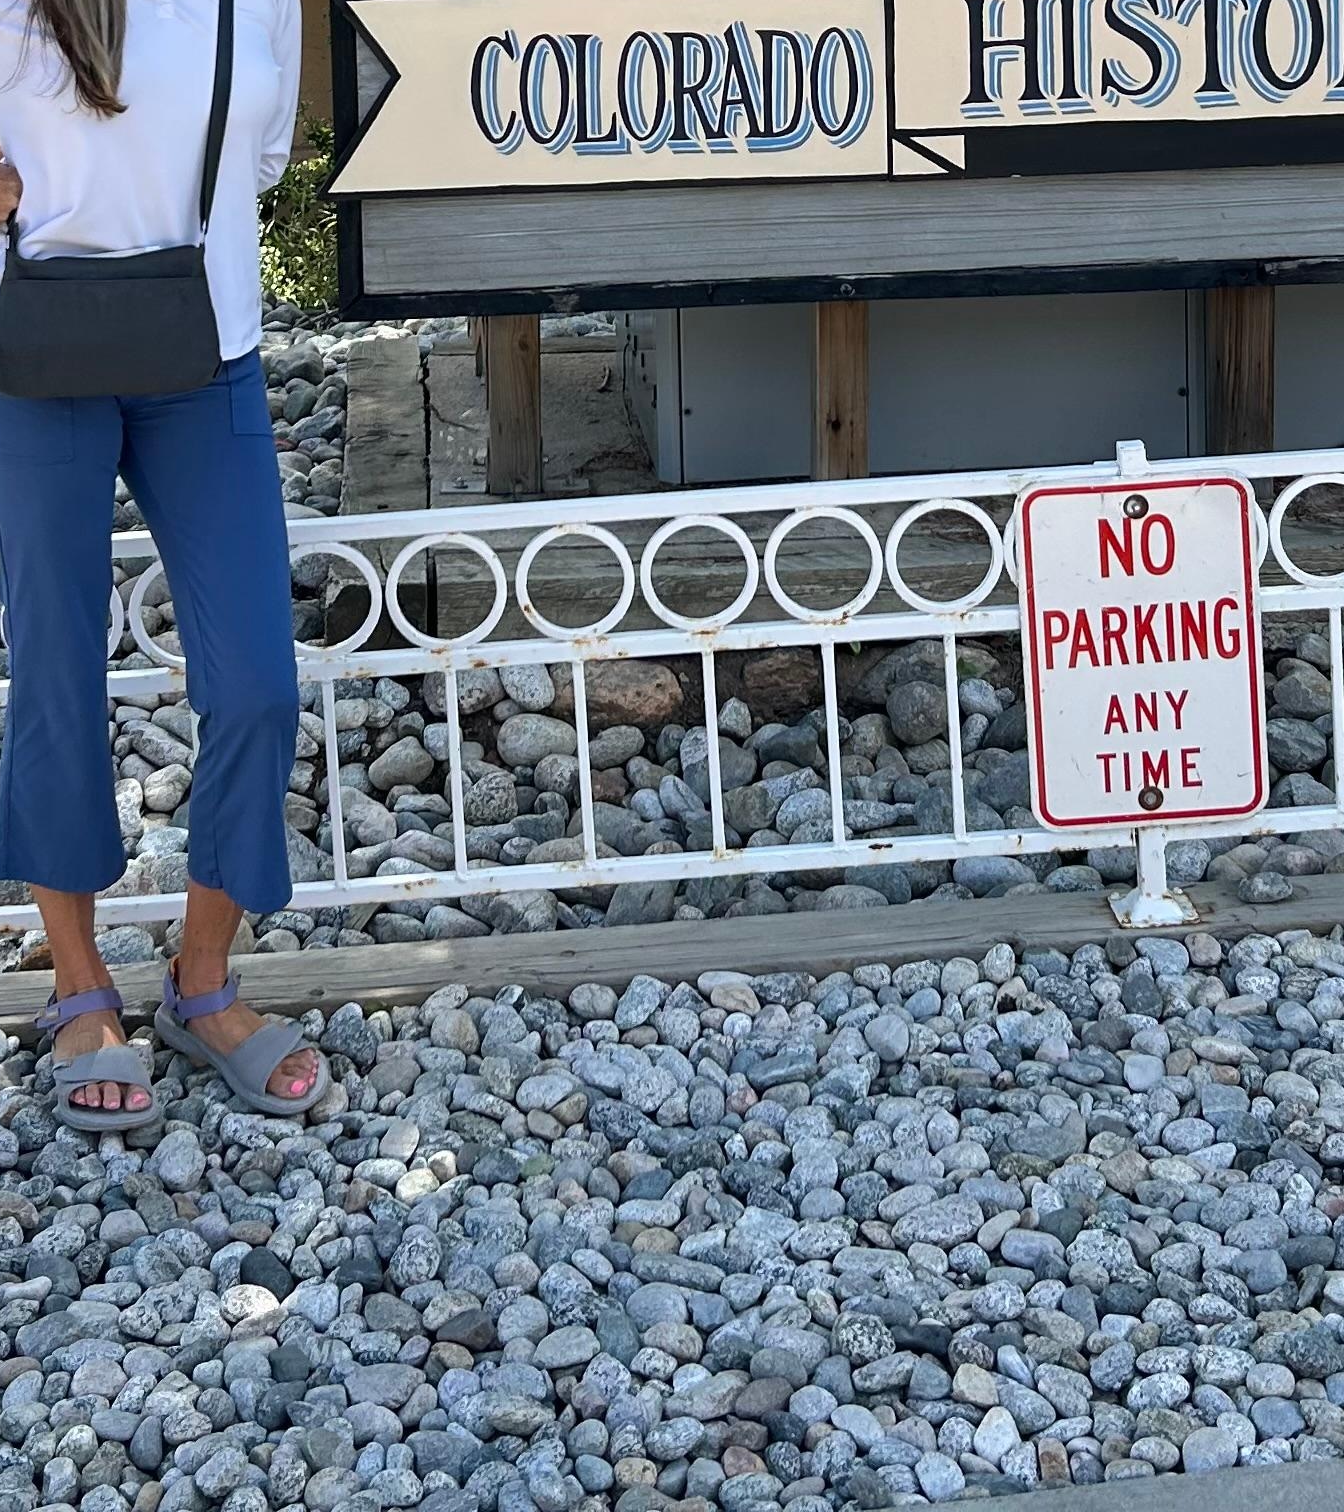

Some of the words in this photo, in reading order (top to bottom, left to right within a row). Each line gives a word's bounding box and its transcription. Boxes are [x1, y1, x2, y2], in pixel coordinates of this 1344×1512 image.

[469, 19, 875, 157] COLORADO
[1097, 513, 1176, 578] NO
[1042, 597, 1242, 670] PARKING
[1104, 689, 1189, 735] ANY
[1096, 746, 1204, 794] TIME
